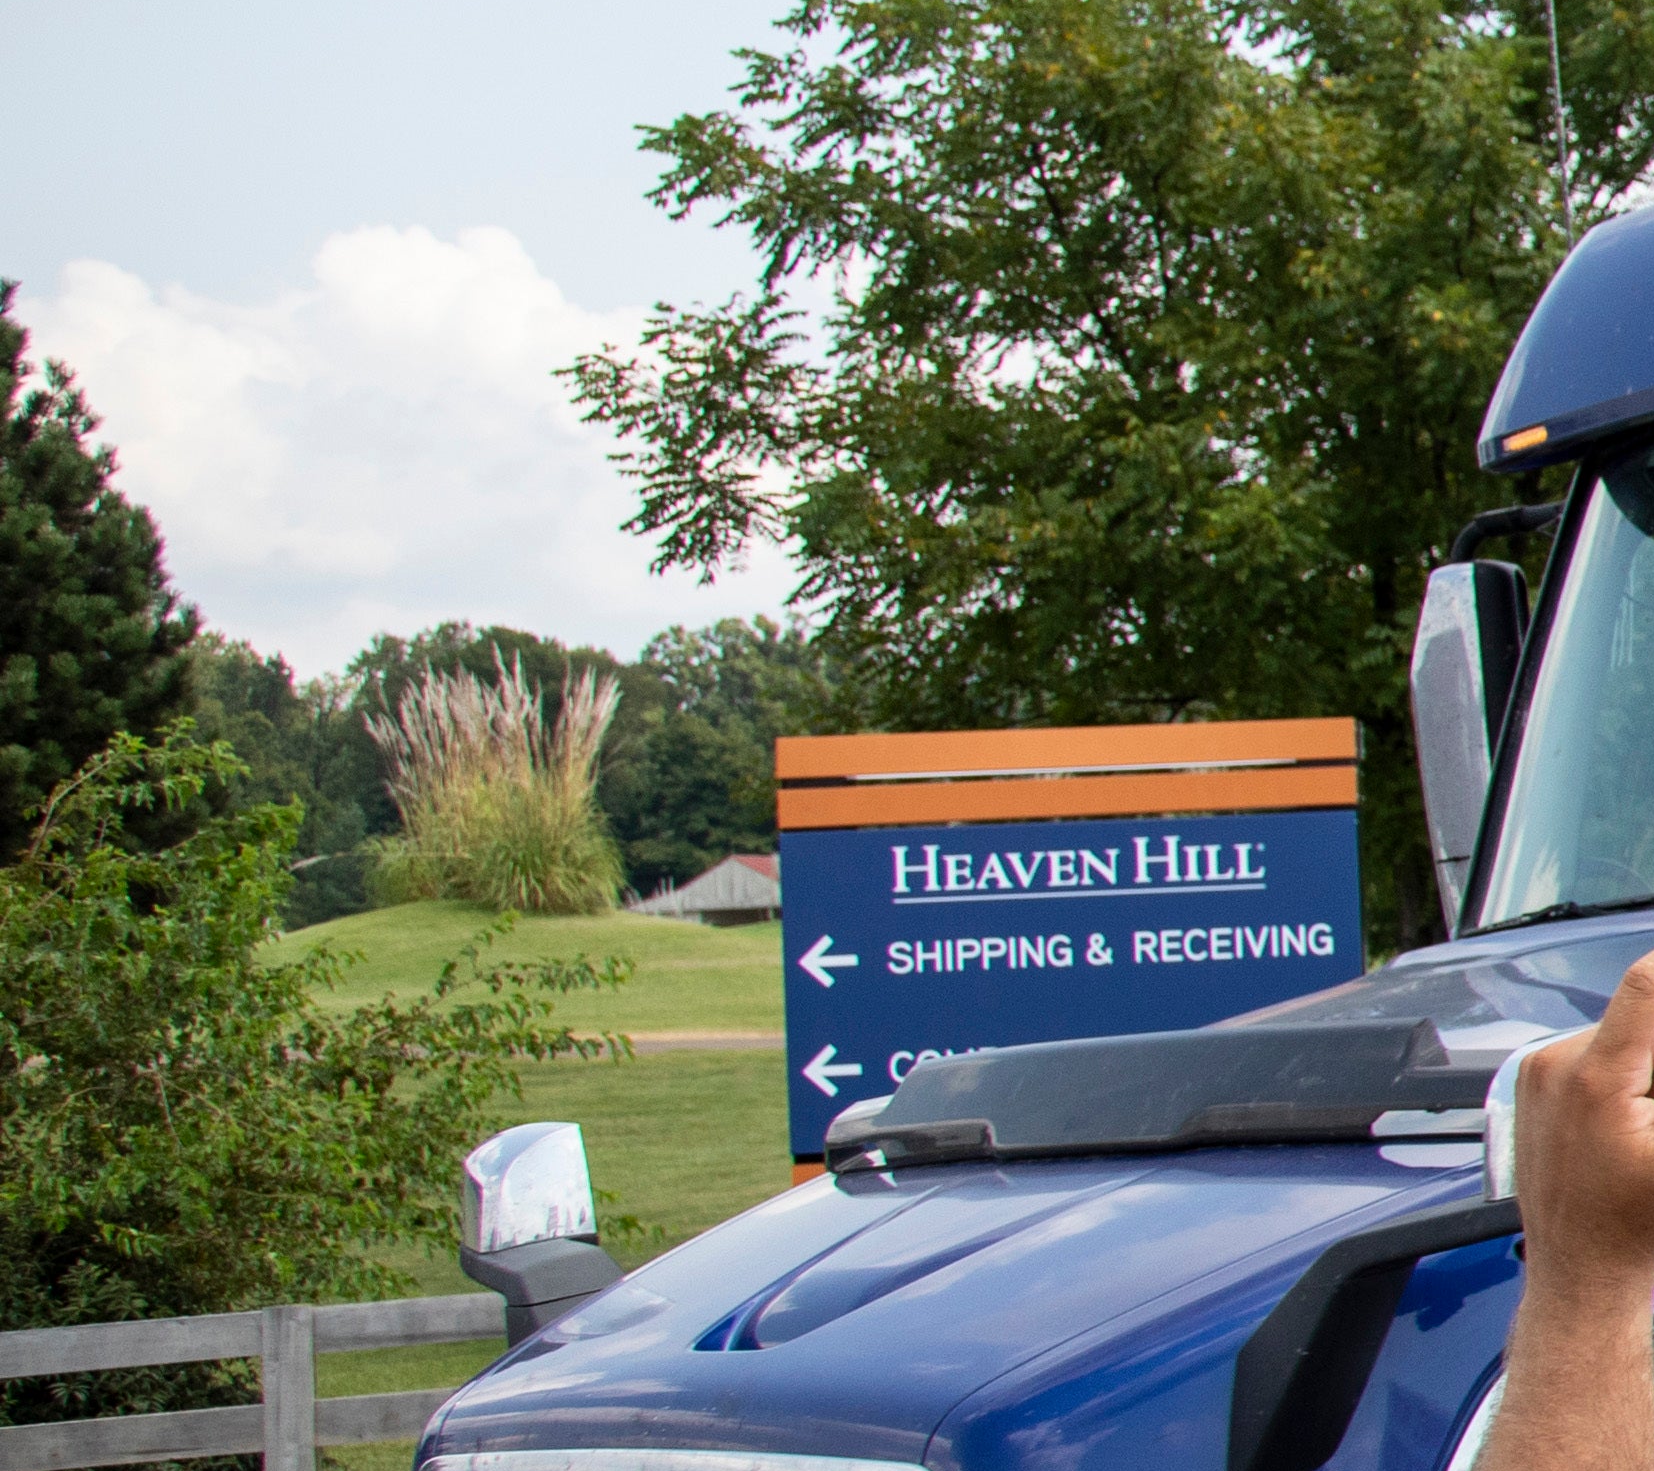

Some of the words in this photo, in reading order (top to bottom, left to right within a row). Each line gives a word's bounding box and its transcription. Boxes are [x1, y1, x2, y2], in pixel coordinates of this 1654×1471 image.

[892, 843, 1119, 893] HEAVEN
[1132, 835, 1266, 883] HILL
[887, 934, 1074, 974] SHIPPING
[1086, 933, 1113, 966] &
[1133, 923, 1334, 964] RECEIVING
